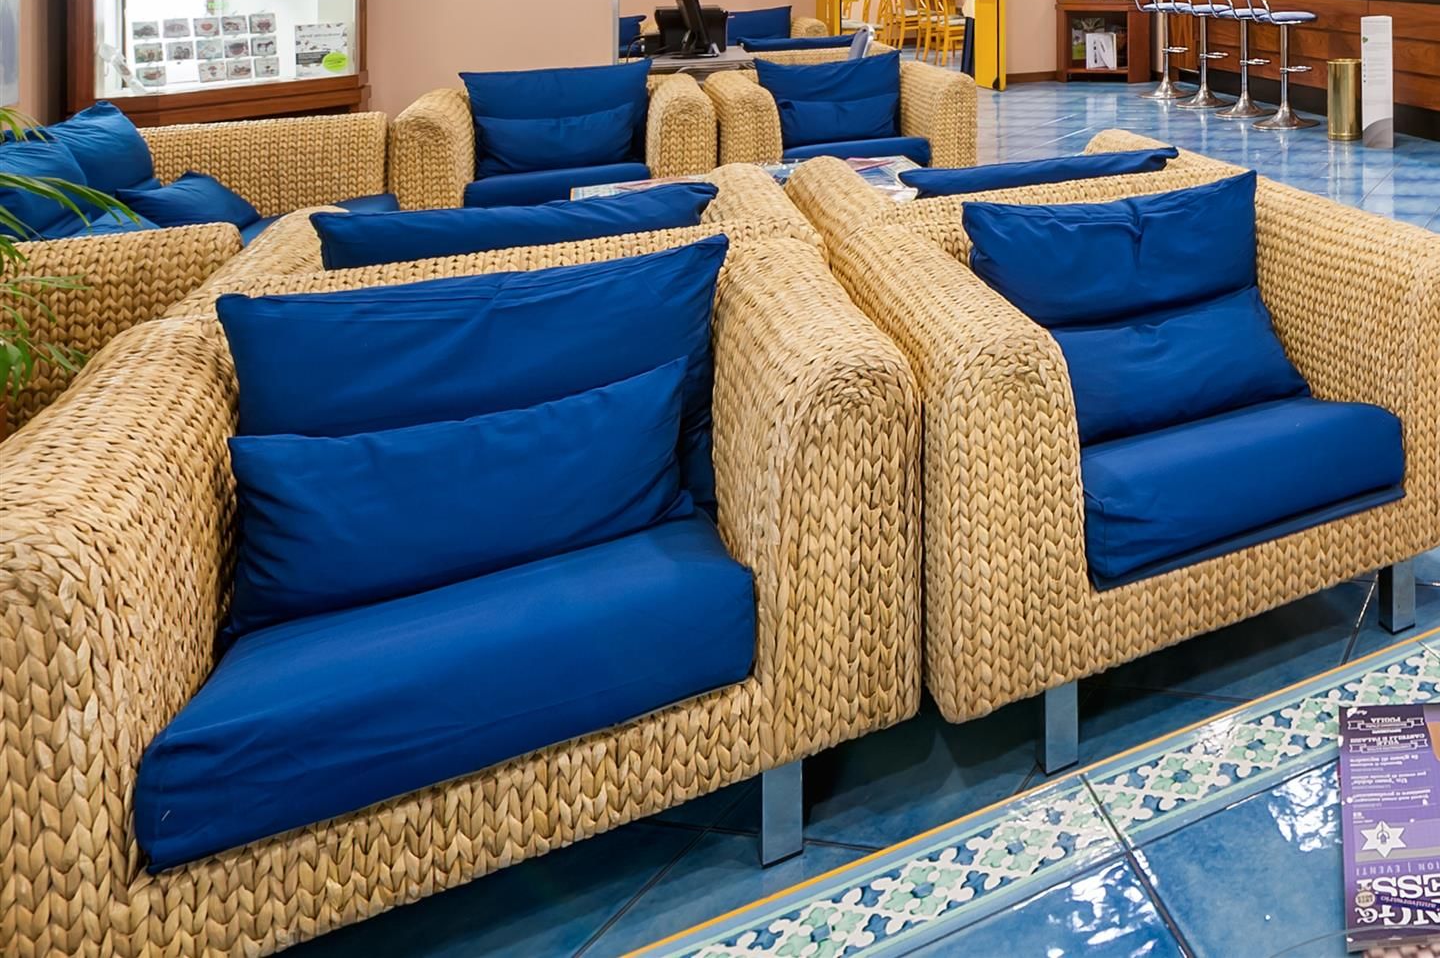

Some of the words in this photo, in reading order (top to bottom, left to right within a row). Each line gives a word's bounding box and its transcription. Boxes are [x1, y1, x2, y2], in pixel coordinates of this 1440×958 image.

[1370, 716, 1401, 724] PUGLIA
[1355, 863, 1401, 877] EVENTI
[1379, 895, 1437, 910] anniversario
